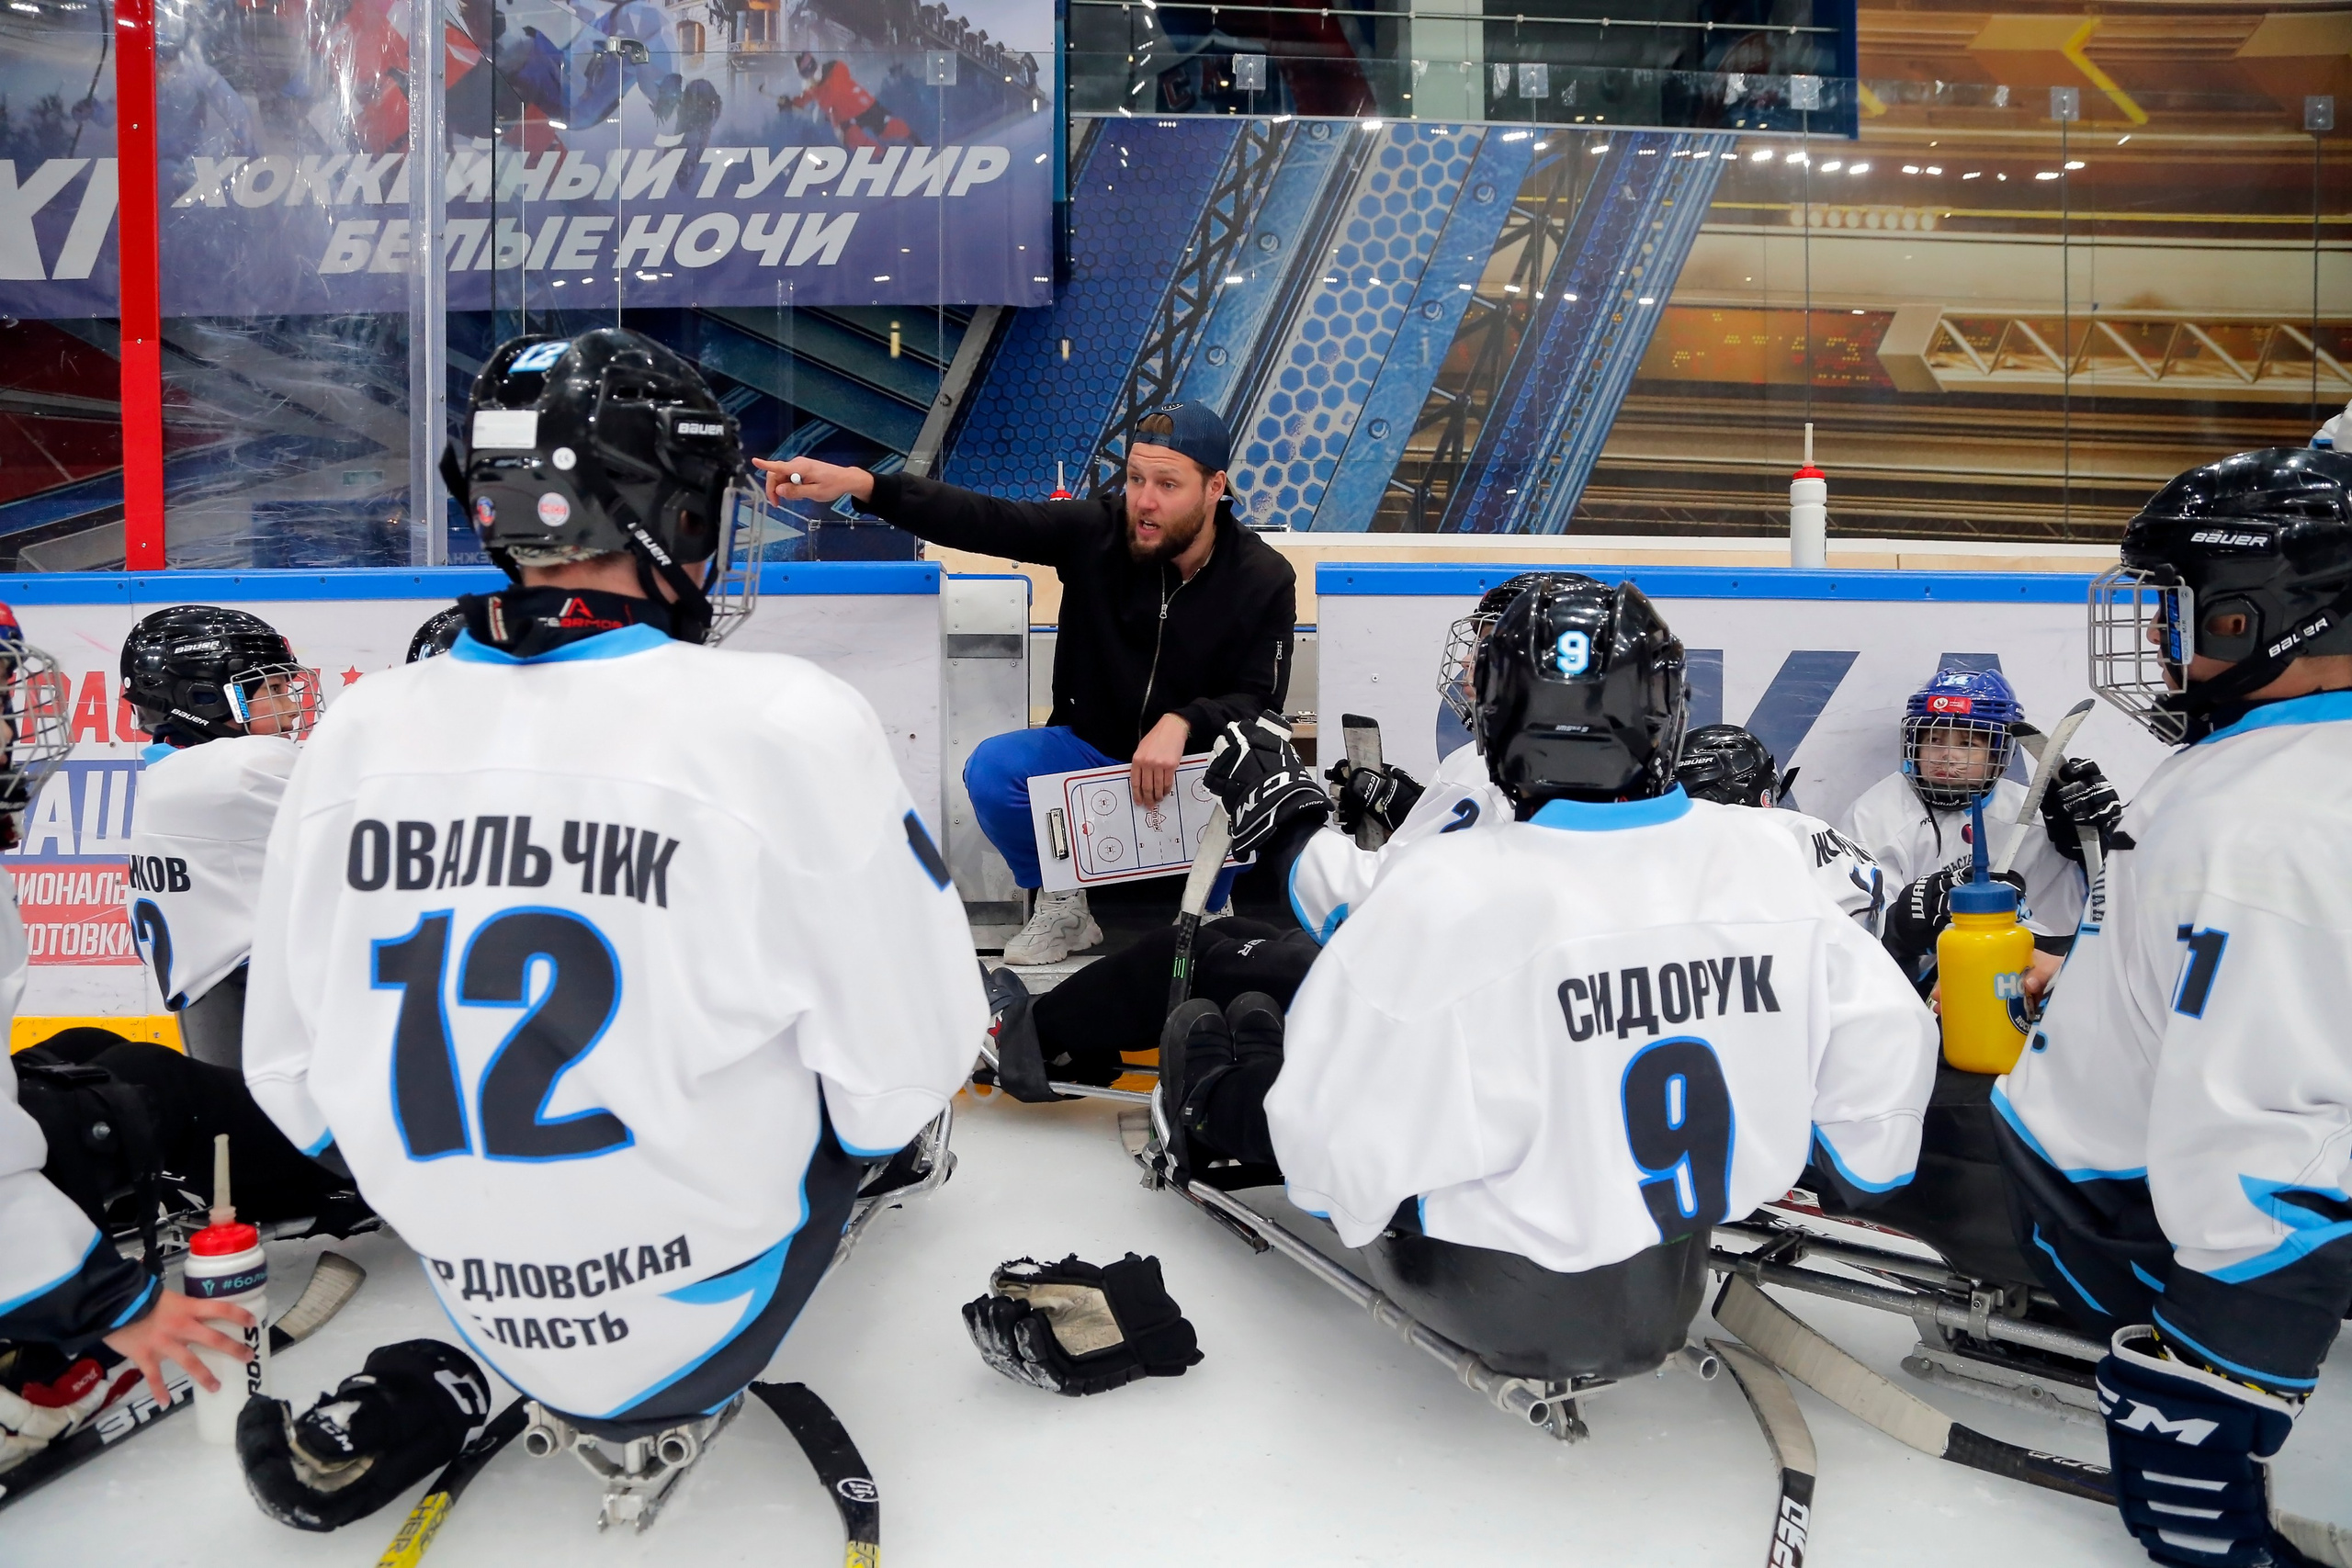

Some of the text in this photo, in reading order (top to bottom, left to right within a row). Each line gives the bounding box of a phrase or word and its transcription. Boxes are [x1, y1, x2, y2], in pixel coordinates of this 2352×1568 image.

[701, 145, 1011, 199] ТУРНИР
[318, 211, 859, 275] БЕЛЫЕ НОЧИ
[509, 343, 571, 374] 12
[677, 422, 725, 435] BAUER
[2190, 532, 2268, 547] BAUER
[174, 640, 220, 654] BAUER
[1556, 630, 1590, 675] 9
[171, 707, 210, 727] BAUER
[347, 816, 680, 908] ОВАЛЬЧИК
[12, 873, 130, 905] ИОНАЛЬ
[22, 922, 135, 956] ОТОВКИ
[1557, 955, 1781, 1042] СИДОРУК
[369, 905, 636, 1163] 12
[1621, 1034, 1736, 1245] 9
